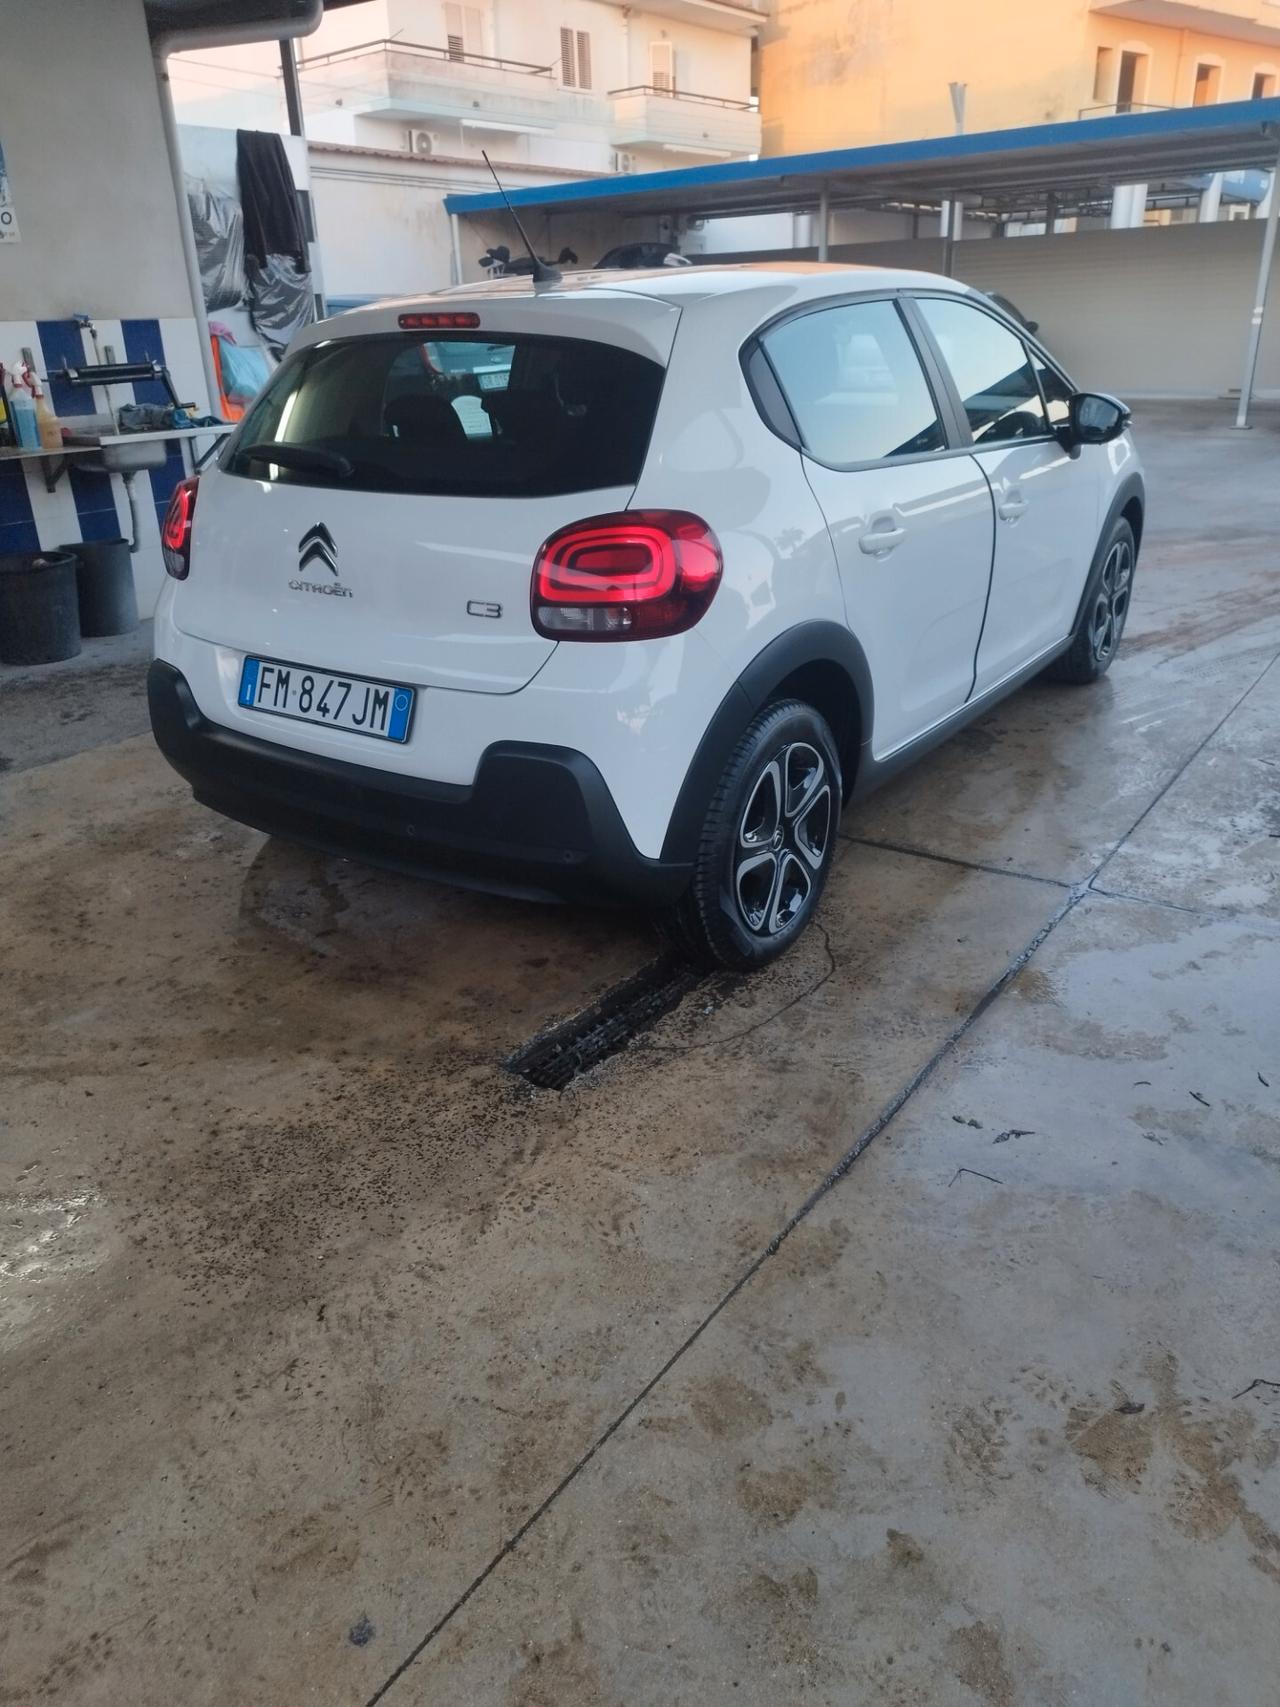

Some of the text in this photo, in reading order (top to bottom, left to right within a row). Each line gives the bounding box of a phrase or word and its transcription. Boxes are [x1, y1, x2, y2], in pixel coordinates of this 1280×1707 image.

[467, 600, 502, 619] C3
[258, 666, 390, 731] FM 847 JM
